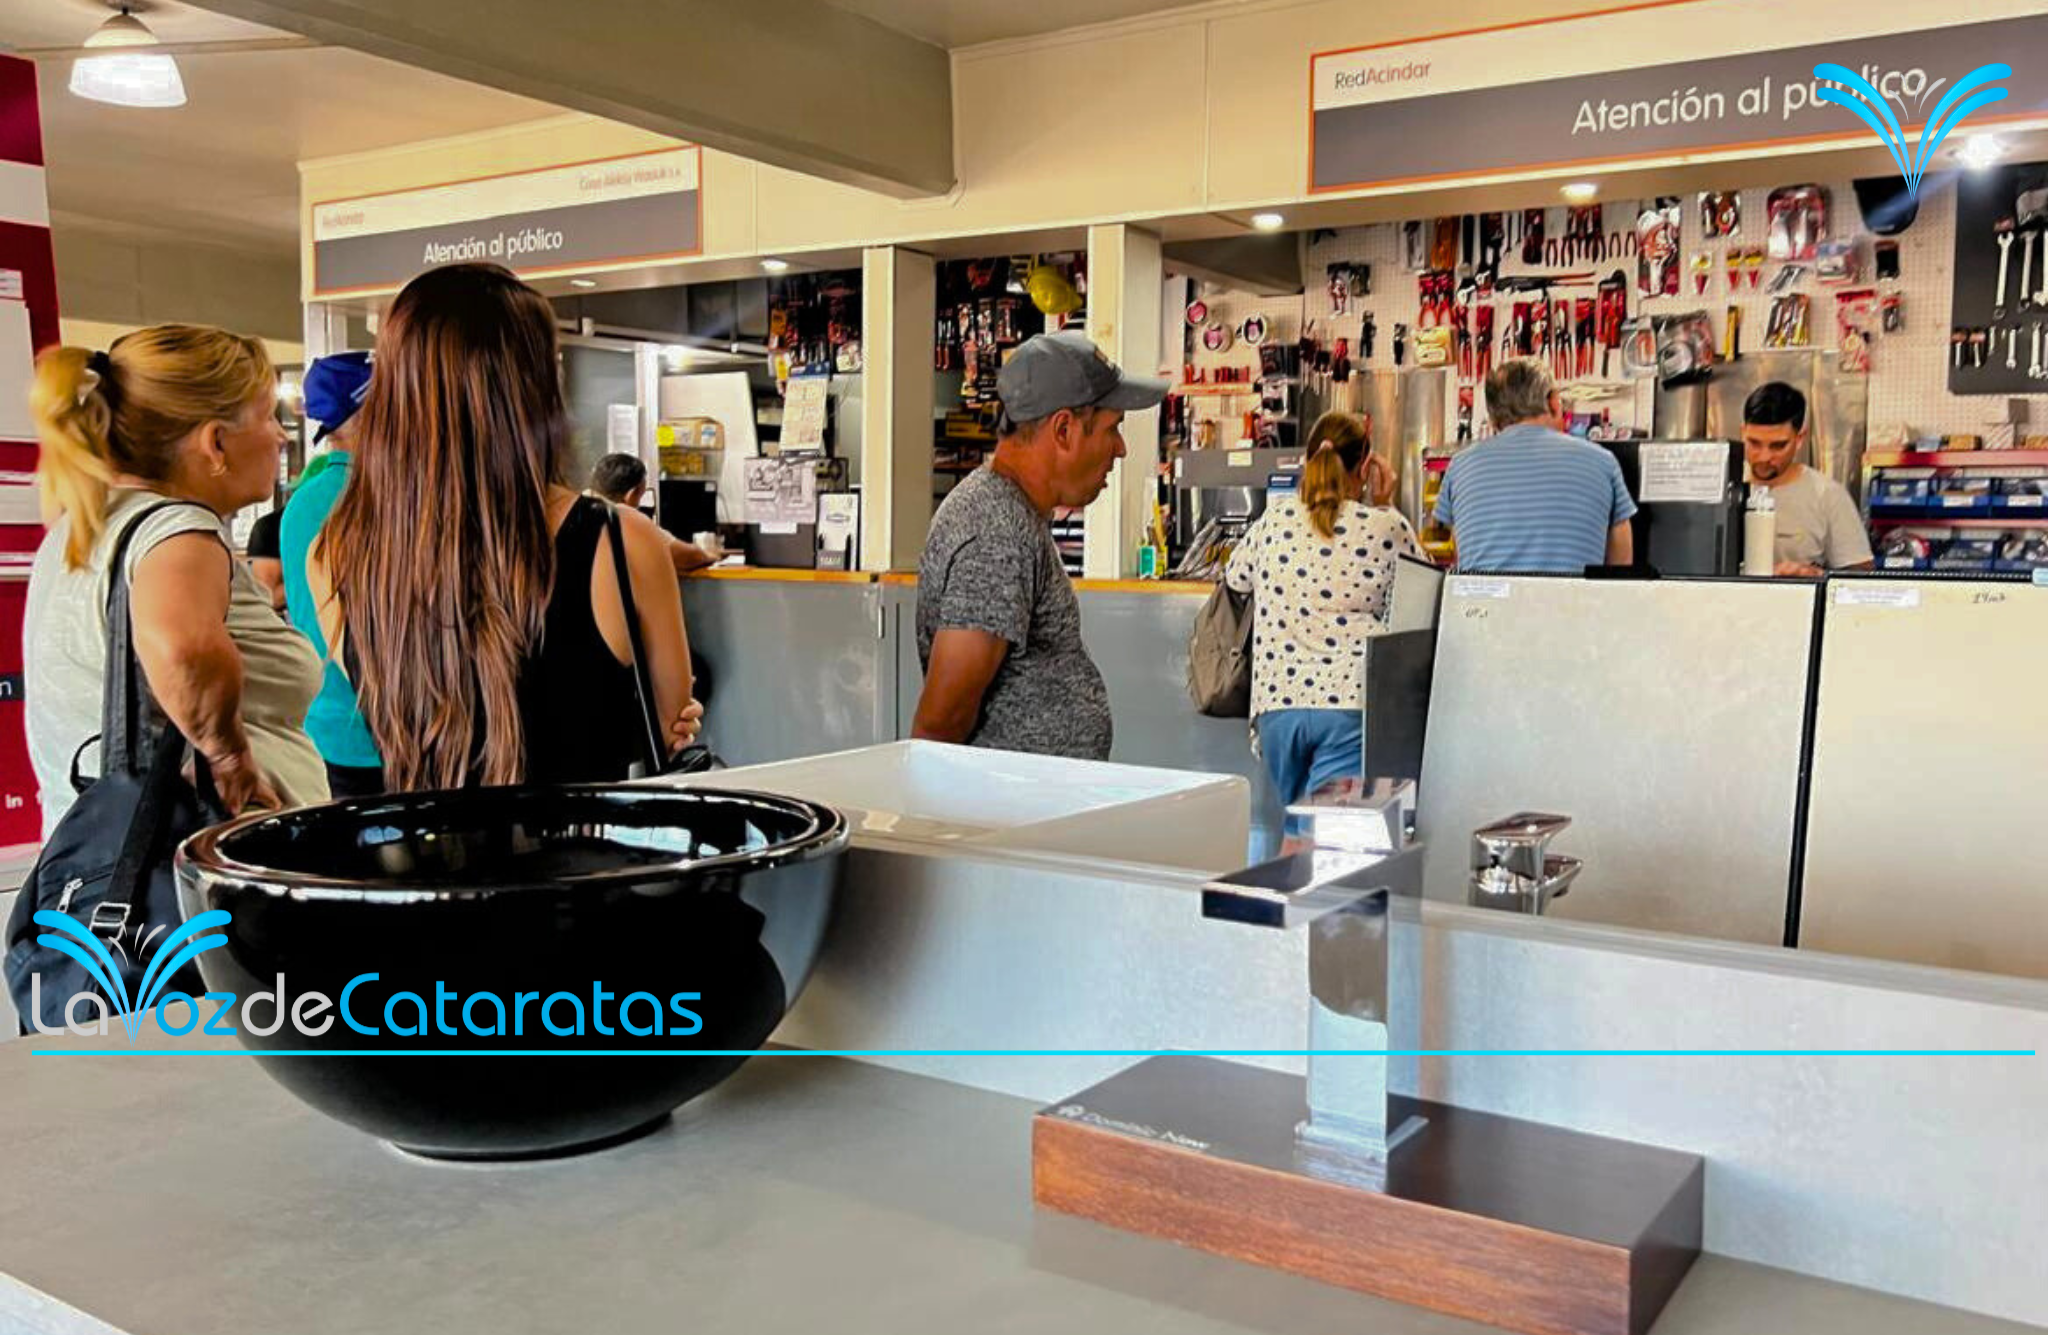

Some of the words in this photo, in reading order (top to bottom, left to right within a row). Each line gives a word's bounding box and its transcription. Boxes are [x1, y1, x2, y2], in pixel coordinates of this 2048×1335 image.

[1334, 60, 1431, 89] RedAcindar
[1571, 86, 1724, 135] Atención
[1737, 76, 1771, 117] al
[1783, 65, 1928, 121] púlico
[423, 235, 486, 264] Atención
[490, 232, 503, 256] al
[508, 227, 563, 261] público
